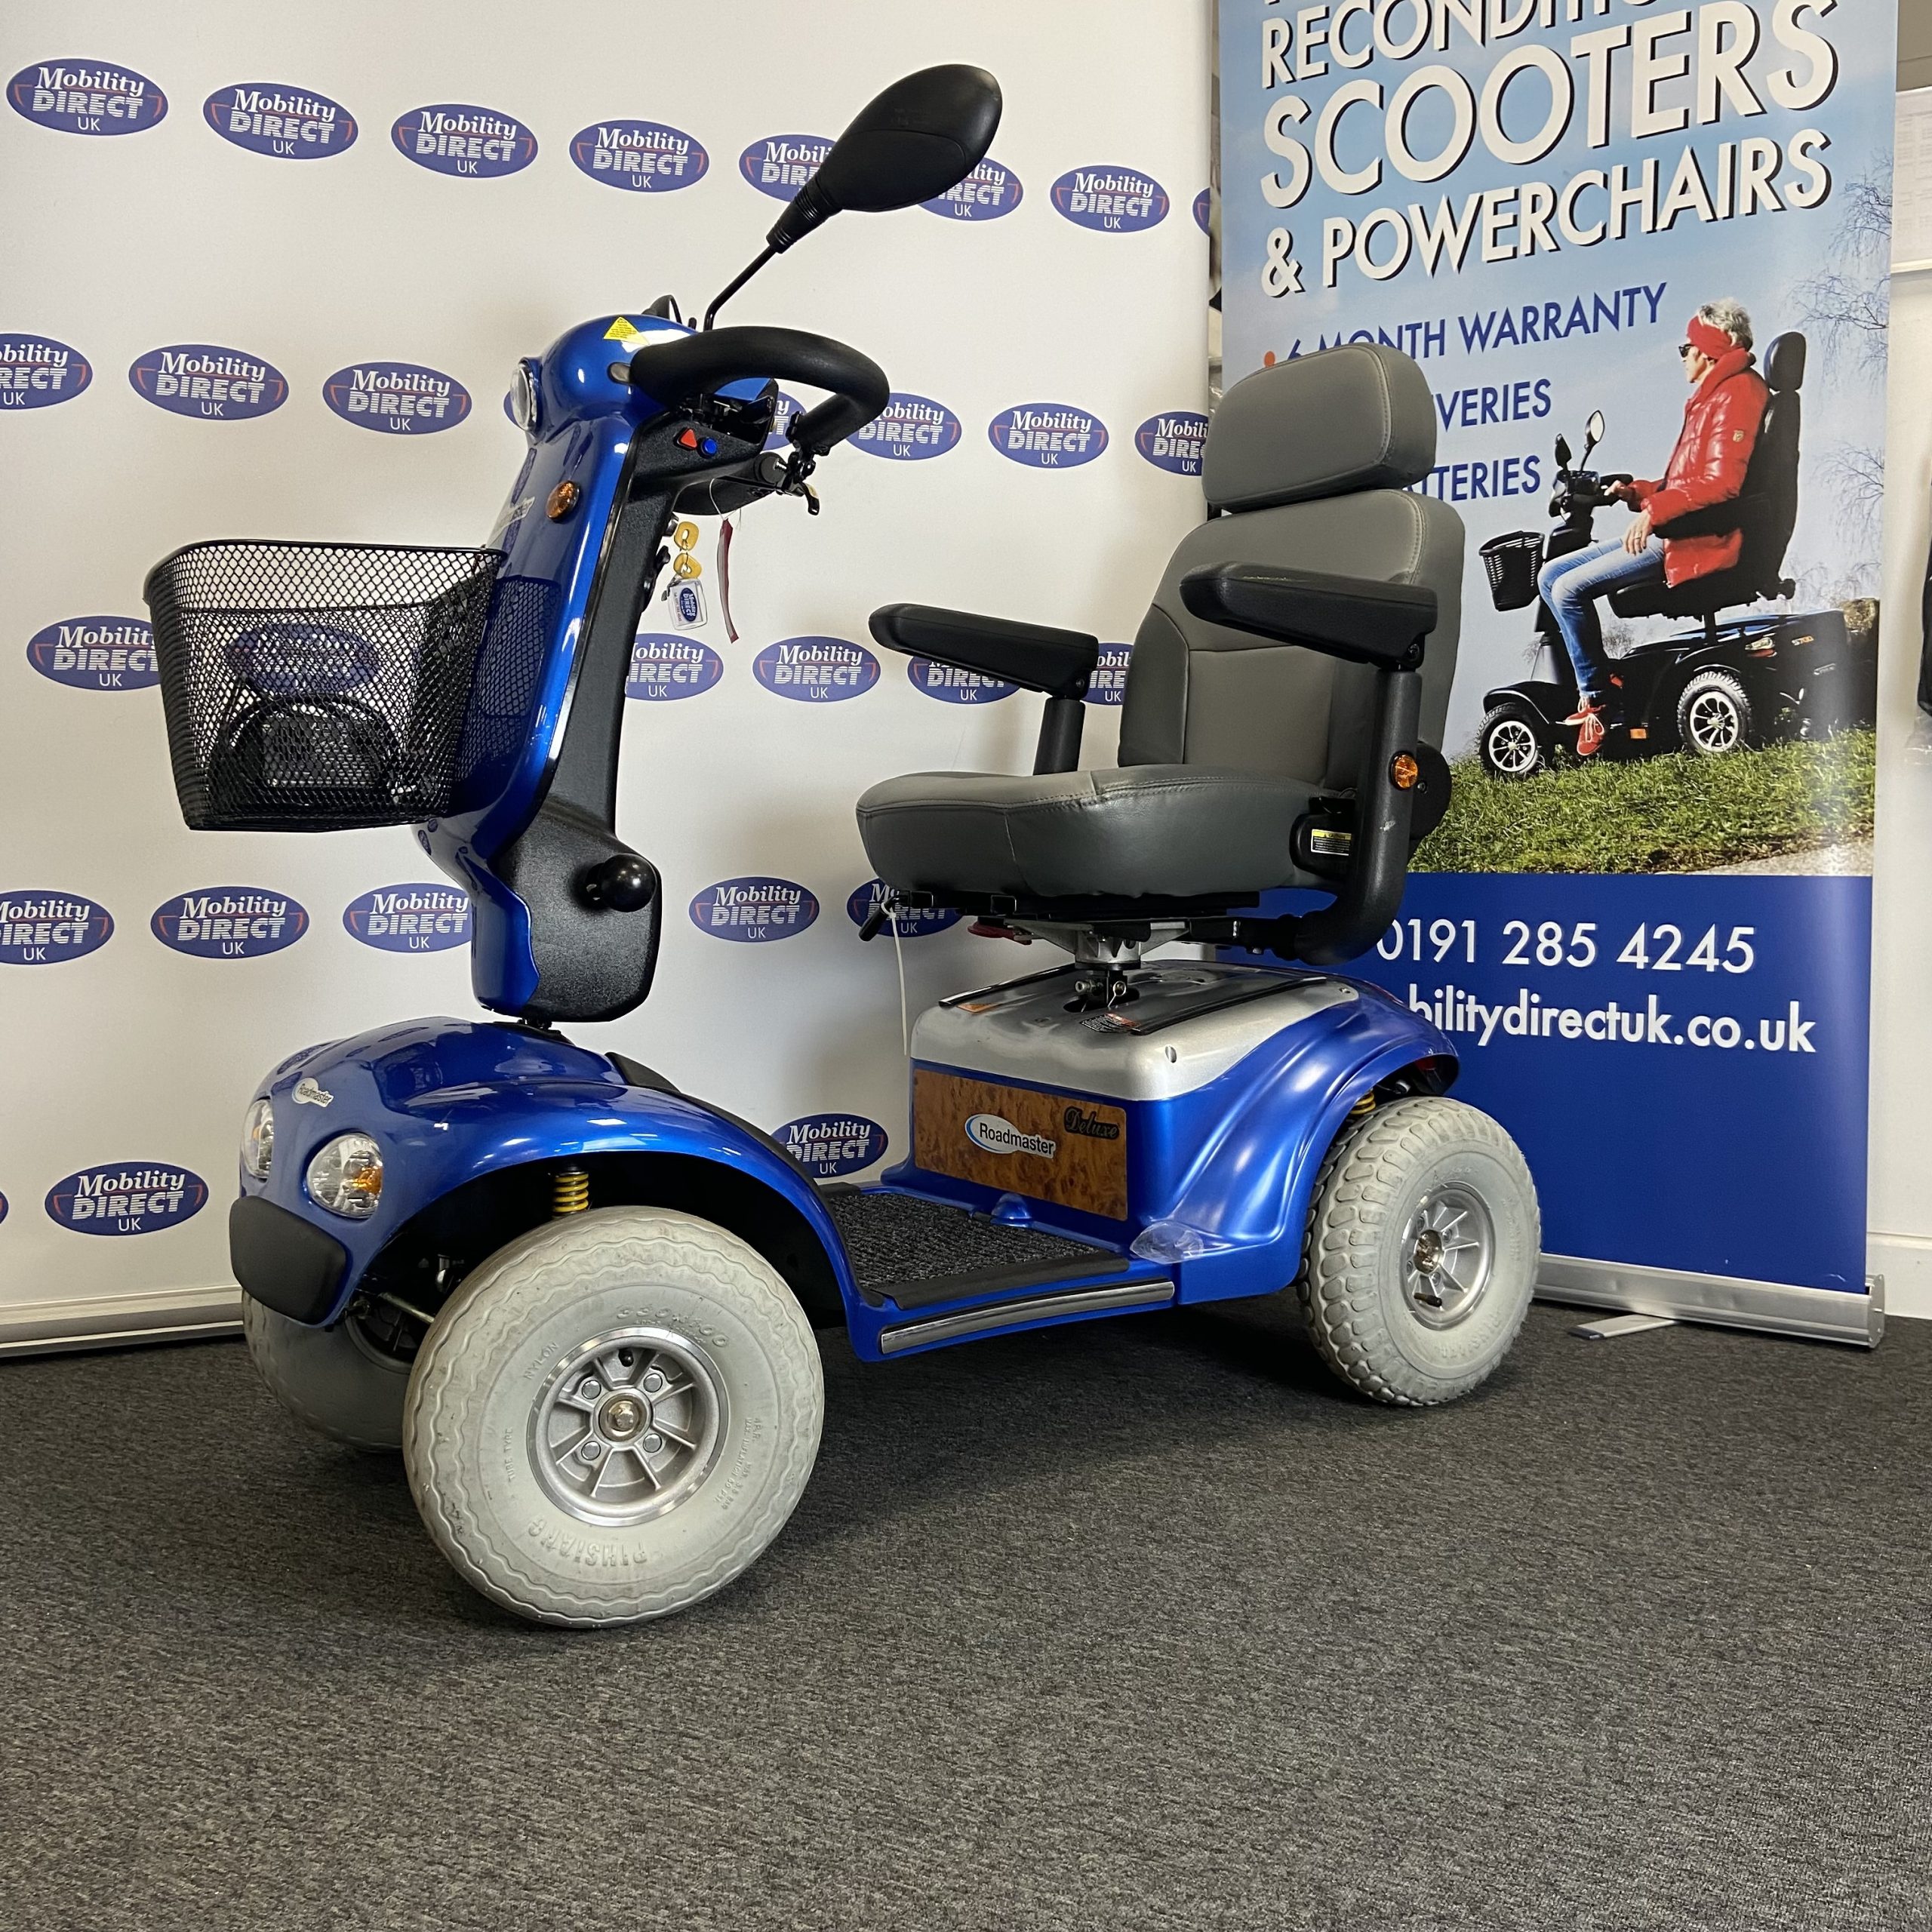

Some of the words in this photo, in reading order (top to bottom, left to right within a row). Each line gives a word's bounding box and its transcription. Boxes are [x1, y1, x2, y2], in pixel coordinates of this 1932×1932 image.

[1262, 0, 1659, 89] RECOND
[35, 66, 144, 96] Mobility
[32, 89, 143, 118] DIRECT
[232, 88, 336, 121] Mobility
[1260, 0, 1838, 208] SCOOTERS
[78, 117, 100, 131] UK
[229, 111, 334, 143] DIRECT
[418, 111, 517, 140] Mobility
[273, 140, 295, 155] UK
[416, 133, 516, 162] DIRECT
[595, 128, 689, 154] Mobility
[457, 161, 478, 174] UK
[593, 149, 688, 176] DIRECT
[632, 175, 651, 188] UK
[968, 164, 1005, 186] lity
[1073, 172, 1153, 197] Mobility
[954, 204, 971, 217] UK
[1070, 192, 1152, 217] DIRECT
[1261, 227, 1302, 297] &
[1322, 129, 1832, 288] POWERCHAIRS
[1103, 217, 1121, 229] UK
[1457, 281, 1667, 355] WARRANTY
[0, 344, 68, 367] bility
[160, 351, 266, 381] Mobility
[156, 375, 265, 404] DIRECT
[352, 370, 451, 395] Mobility
[3, 392, 26, 405] UK
[202, 401, 224, 417] UK
[348, 392, 450, 418] DIRECT
[1432, 378, 1551, 432] VERIES
[390, 417, 411, 430] UK
[877, 402, 944, 425] obility
[1011, 410, 1091, 434] Mobility
[858, 422, 943, 444] DIRECT
[1008, 429, 1091, 452] DIRECT
[893, 445, 911, 457] UK
[1041, 453, 1058, 465] UK
[1182, 460, 1196, 472] UK
[631, 643, 703, 663] obility
[777, 645, 862, 665] Mobility
[1097, 651, 1130, 666] obil
[99, 673, 122, 687] UK
[629, 663, 703, 683] IRECT
[774, 664, 860, 685] DIRECT
[1089, 670, 1126, 688] IRE
[648, 685, 667, 697] UK
[810, 686, 829, 699] UK
[960, 689, 977, 700] UK
[1105, 691, 1121, 702] UK
[180, 895, 287, 918] Mobility
[370, 892, 469, 914] Mobility
[714, 885, 801, 906] Mobility
[368, 913, 468, 935] DIRECT
[711, 905, 800, 926] DIRECT
[0, 922, 89, 945] IRECT
[177, 918, 285, 941] DIRECT
[747, 927, 767, 939] UK
[900, 922, 918, 934] UK
[23, 947, 46, 961] UK
[222, 940, 245, 954] UK
[409, 937, 430, 949] UK
[1377, 918, 1476, 963] 0191
[1502, 920, 1597, 968] 285
[1617, 921, 1755, 974] 4245
[786, 1121, 870, 1144] Mobility
[1066, 1108, 1118, 1138] Deluxe
[980, 1122, 1054, 1155] Roadmaster
[786, 1139, 869, 1162] DIRECT
[820, 1162, 837, 1174] UK
[75, 1171, 186, 1198] Mobility
[72, 1190, 183, 1220] DIRECT
[118, 1217, 141, 1232] UK
[523, 1342, 558, 1380] NYLON
